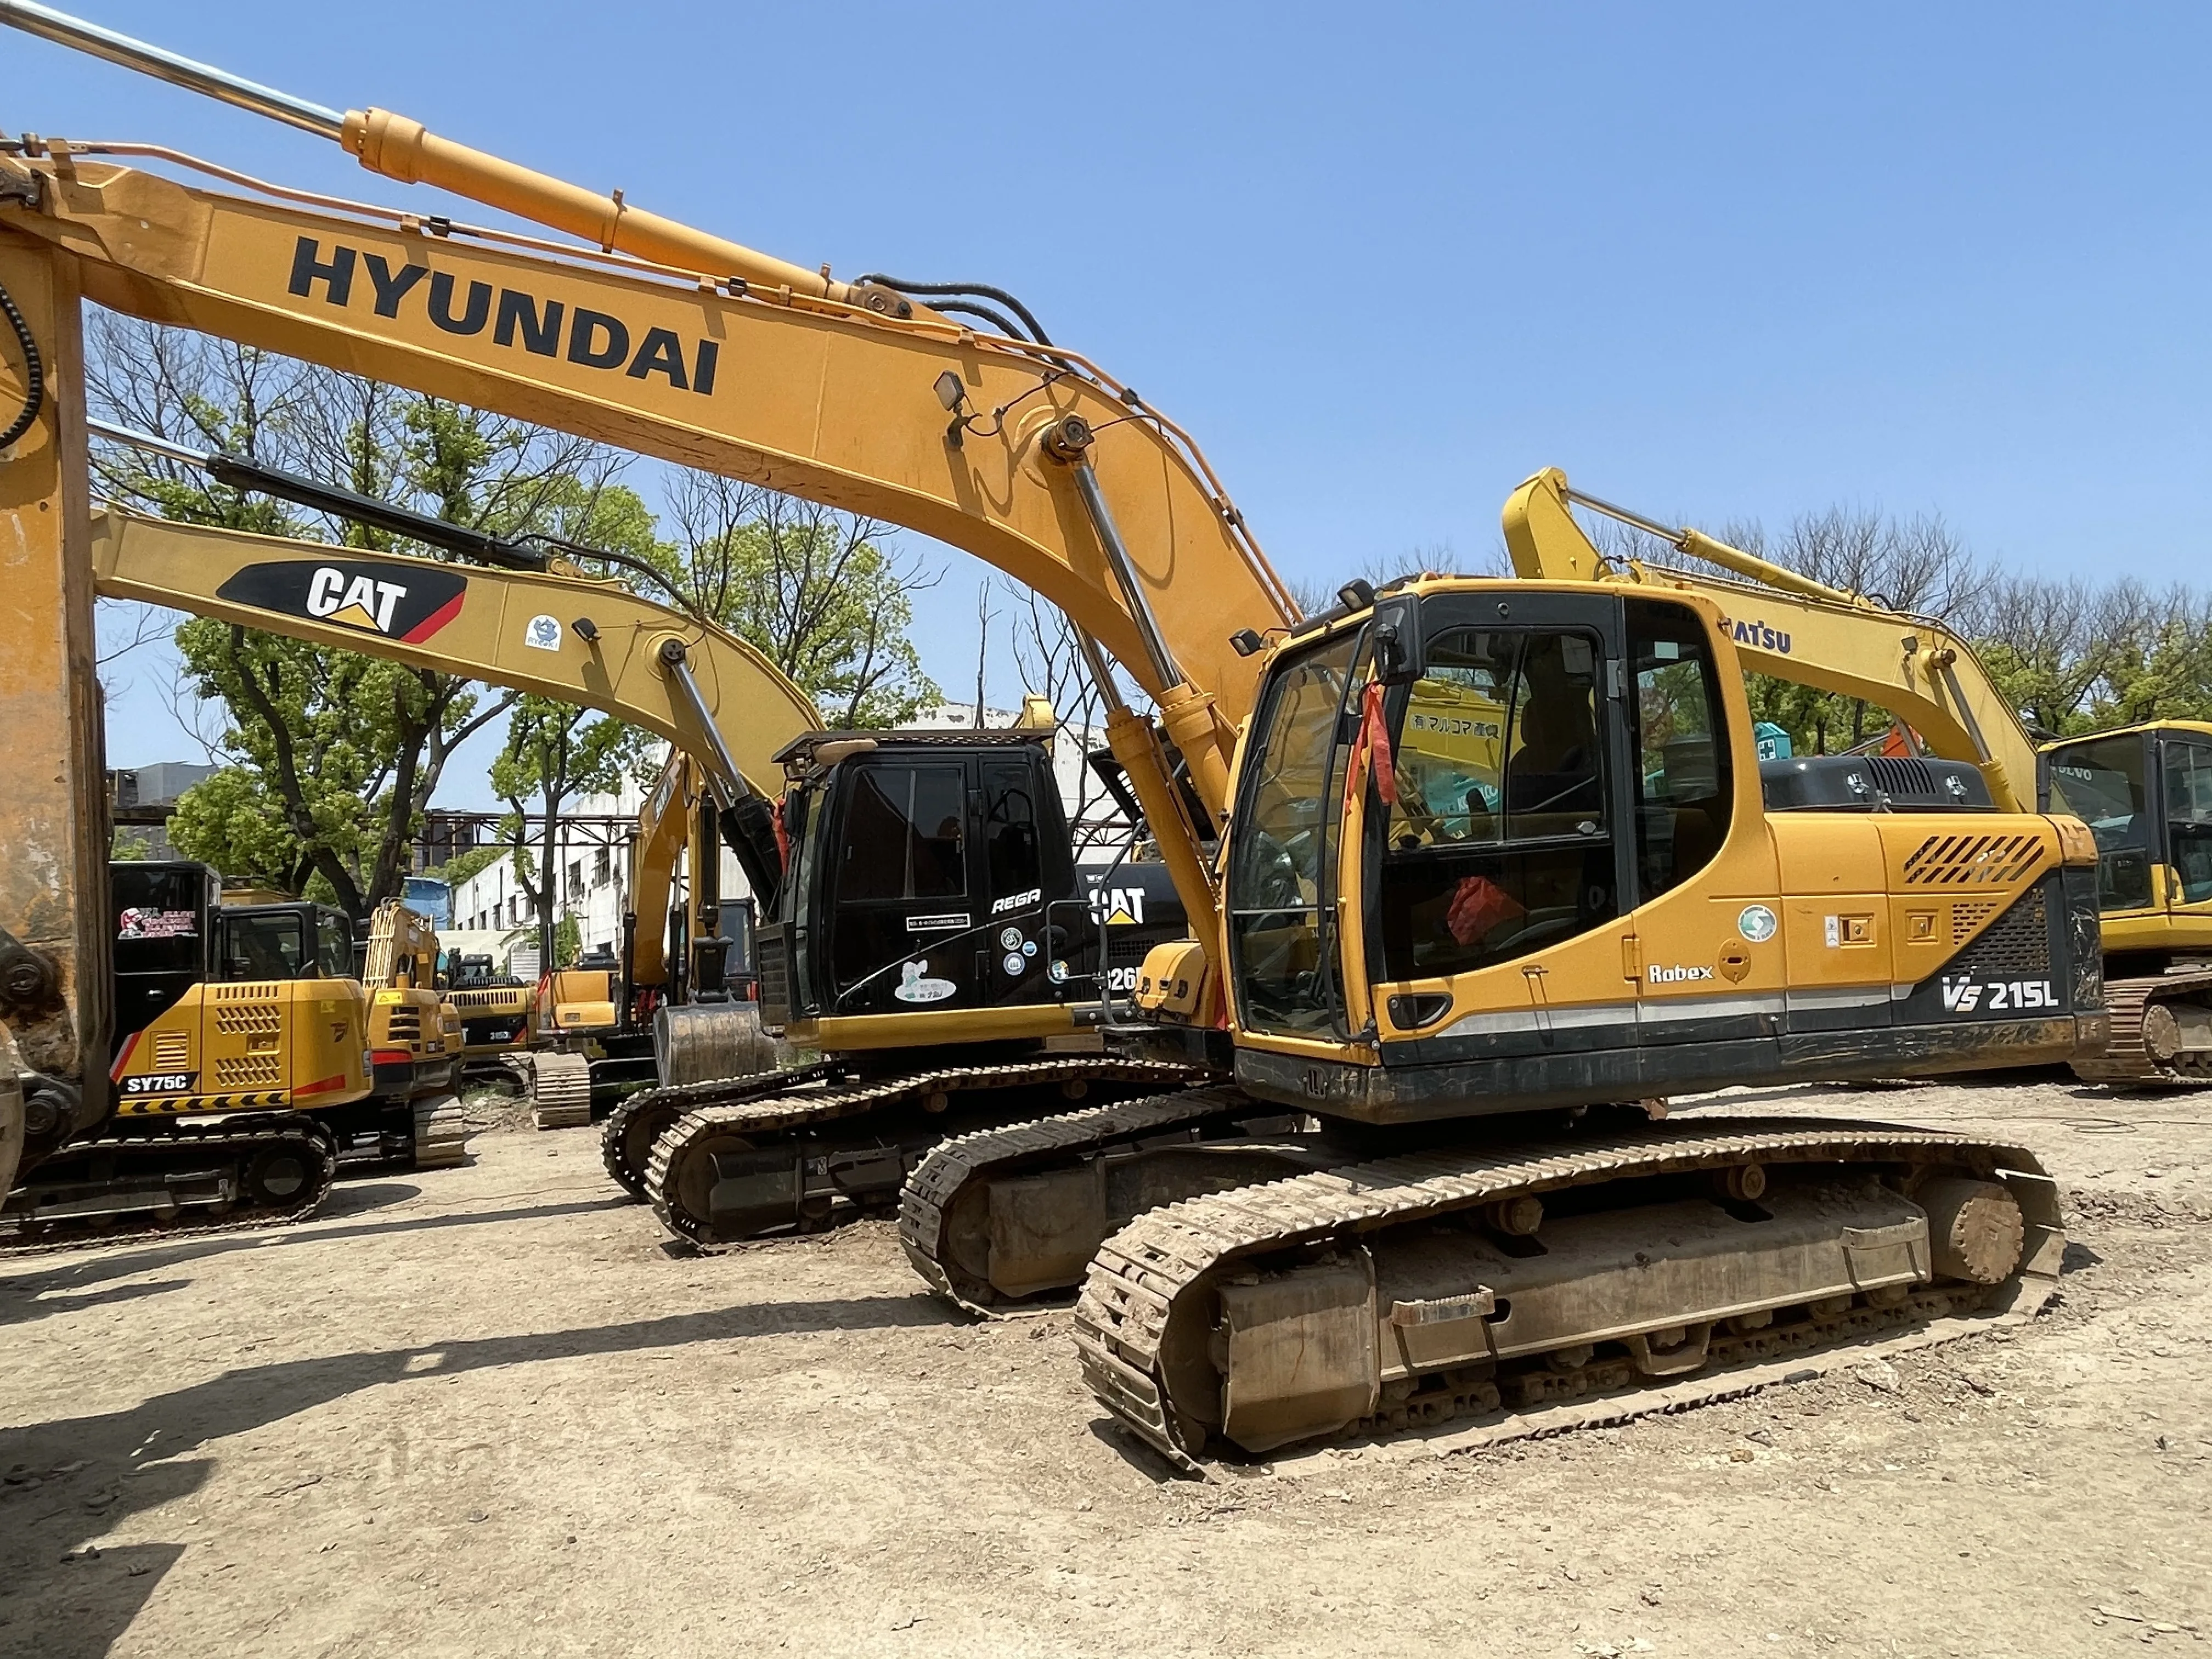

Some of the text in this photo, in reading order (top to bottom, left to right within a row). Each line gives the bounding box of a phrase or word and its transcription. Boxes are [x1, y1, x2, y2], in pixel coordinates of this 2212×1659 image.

[287, 235, 719, 396] HYUNDAI
[306, 567, 407, 633] CAT
[1732, 620, 1791, 654] ATSU
[2050, 766, 2092, 781] OLVO
[991, 888, 1041, 915] REGA
[1648, 963, 1714, 983] Robex
[1987, 980, 2060, 1010] 215L
[127, 1075, 187, 1092] SY75C
